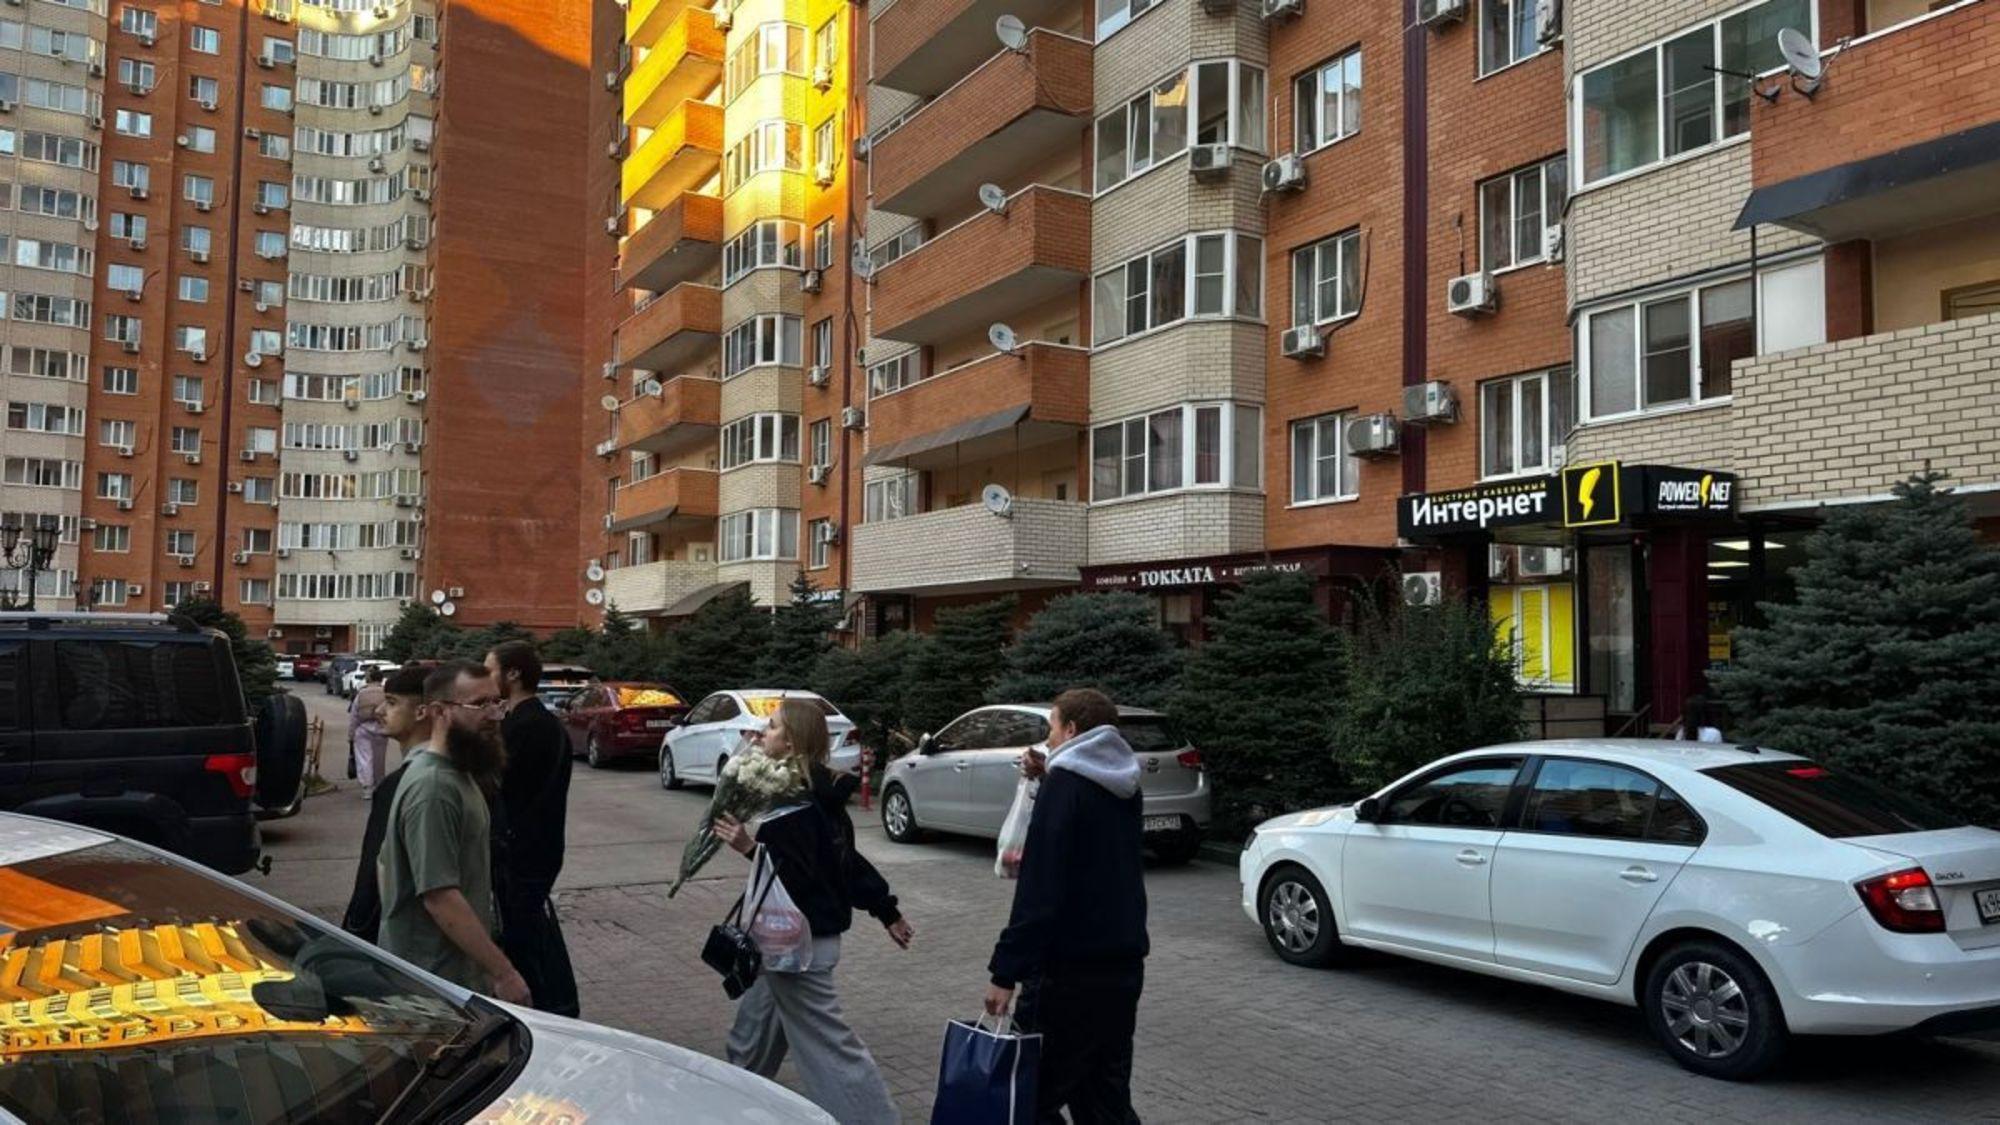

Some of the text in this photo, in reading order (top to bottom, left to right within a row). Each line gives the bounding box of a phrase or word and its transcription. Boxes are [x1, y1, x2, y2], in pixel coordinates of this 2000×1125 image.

[1432, 480, 1547, 503] БЫСТРЫЙ КАБЕЛЬНЫЙ
[1659, 481, 1732, 502] POWER NET
[1412, 490, 1547, 529] Интернет
[1138, 566, 1215, 587] ТОККАТА
